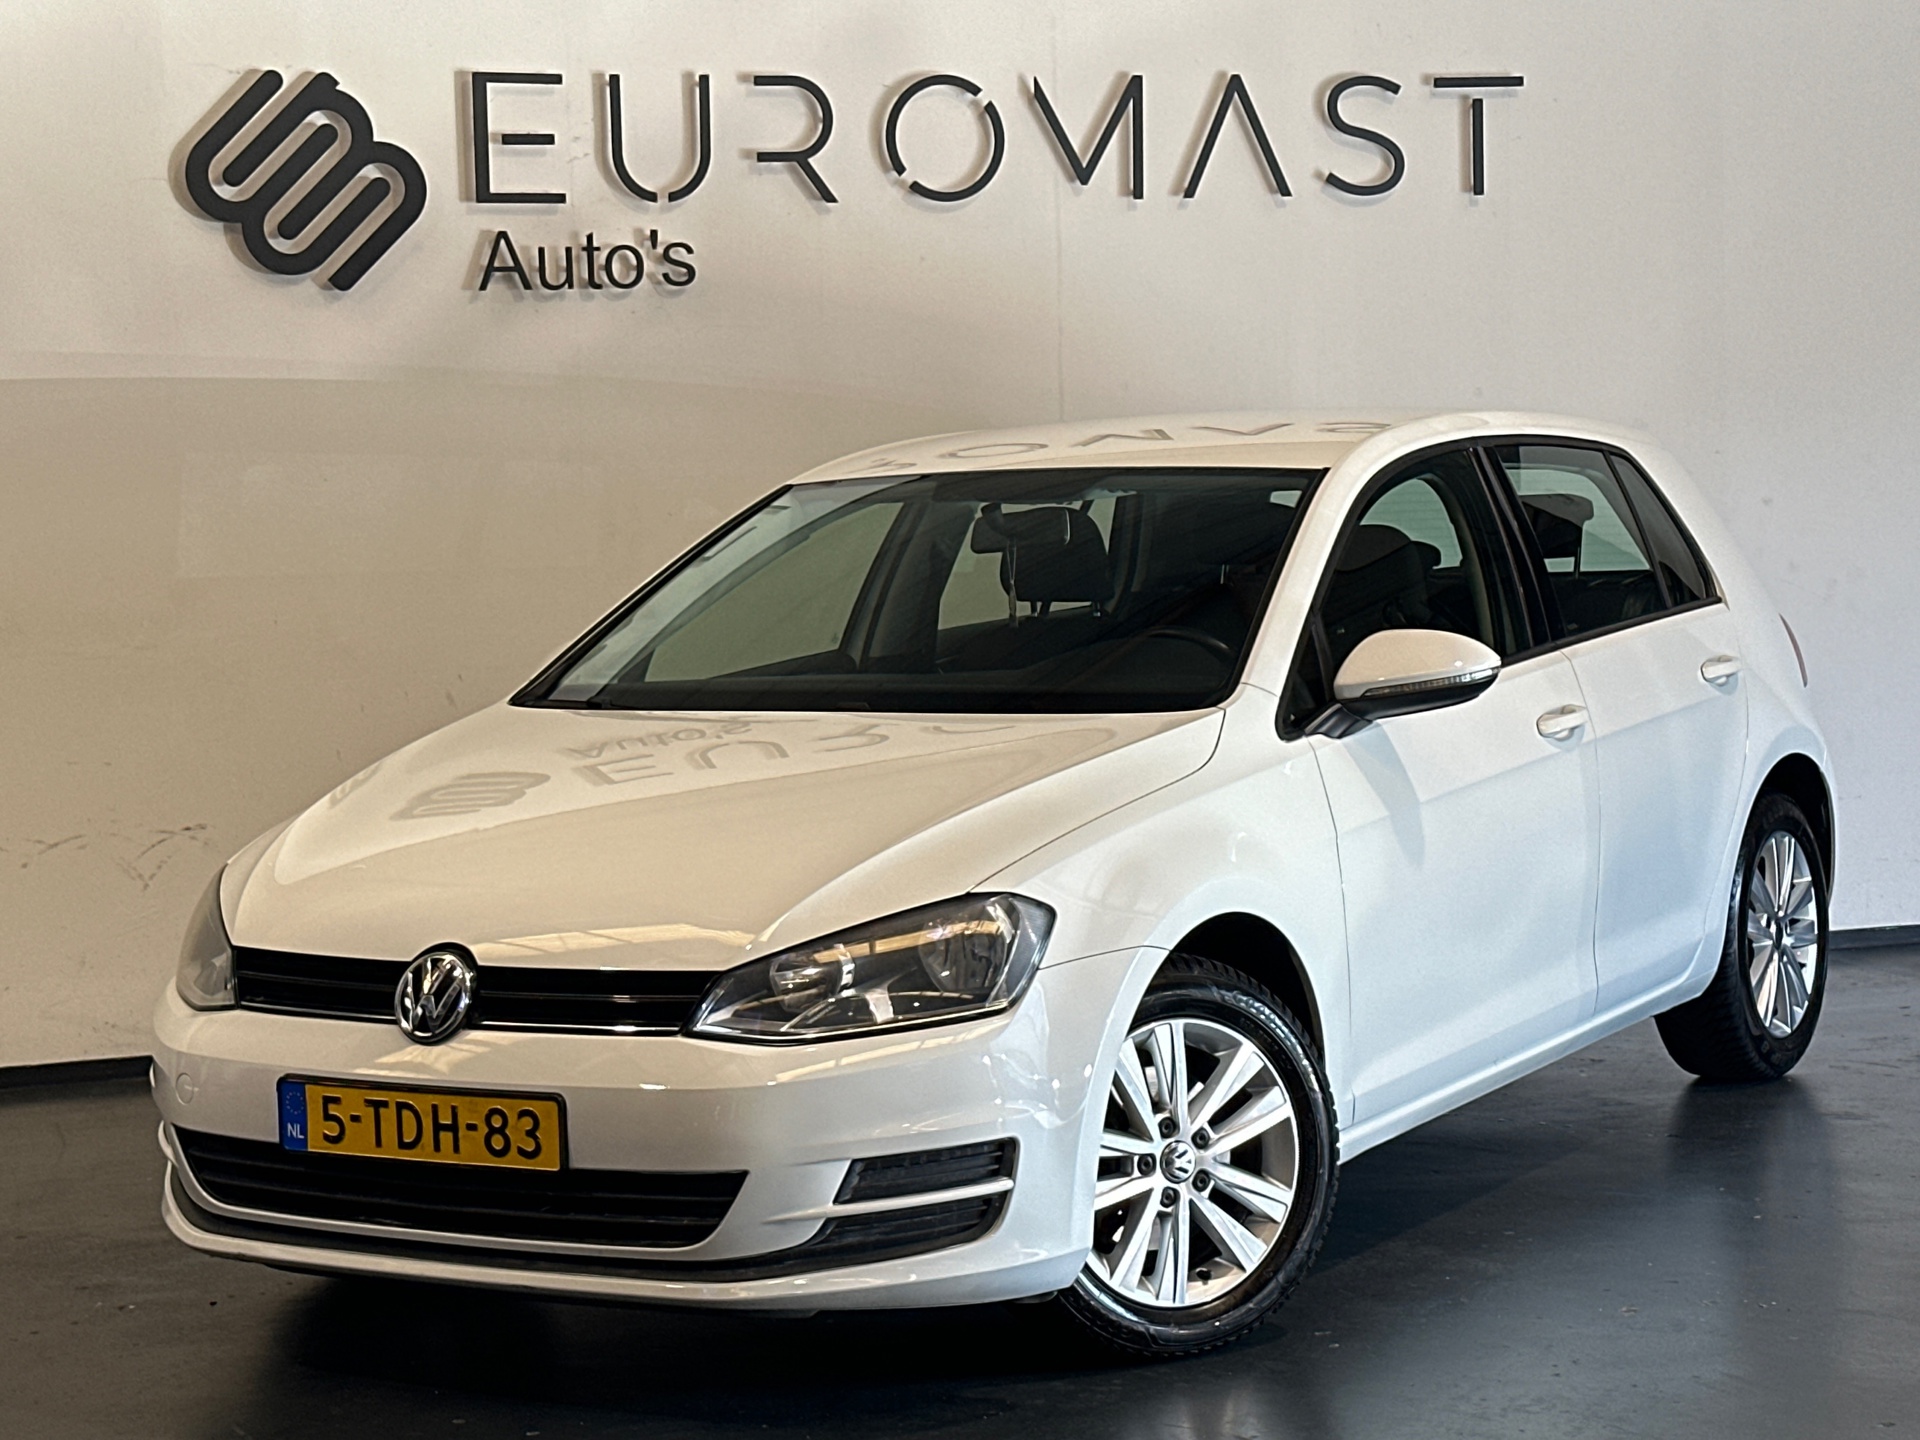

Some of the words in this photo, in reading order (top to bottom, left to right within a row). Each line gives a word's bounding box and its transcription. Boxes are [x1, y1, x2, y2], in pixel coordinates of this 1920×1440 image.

[471, 71, 1524, 204] EUROMAST
[479, 229, 697, 292] Auto's
[287, 1122, 305, 1139] NL
[321, 1094, 543, 1160] 5-TDH-83
